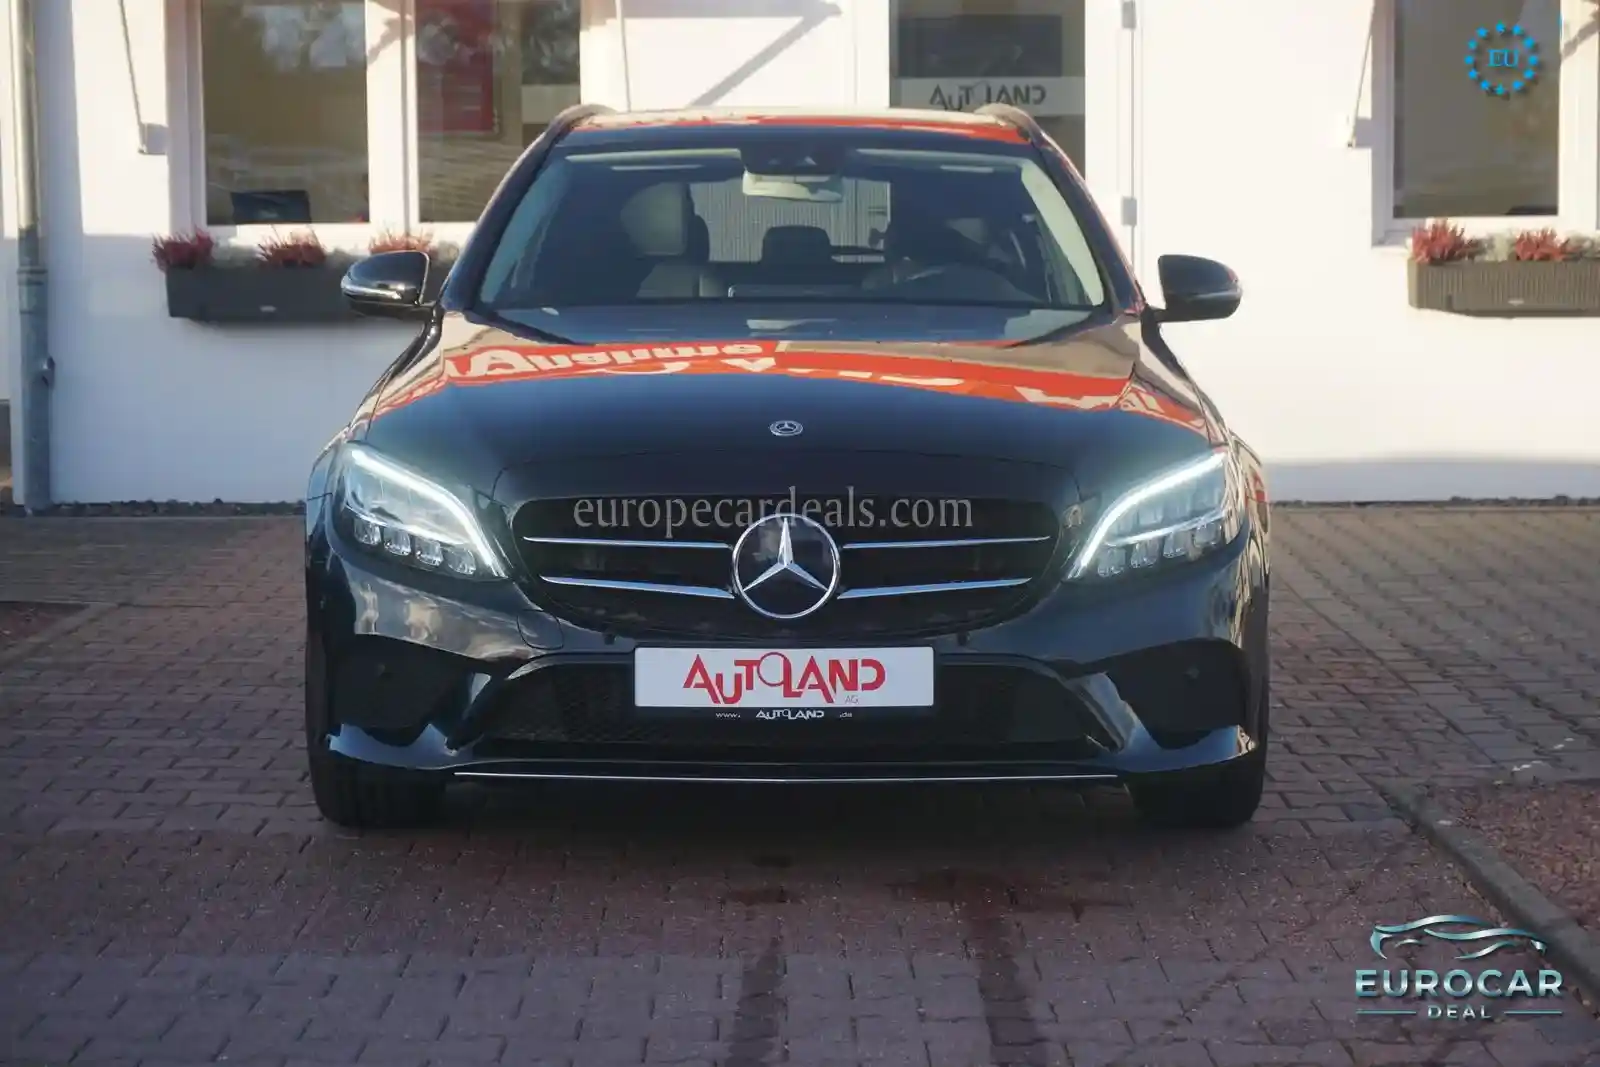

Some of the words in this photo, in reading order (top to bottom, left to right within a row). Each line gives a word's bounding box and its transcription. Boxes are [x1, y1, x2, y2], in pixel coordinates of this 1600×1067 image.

[683, 651, 886, 705] AUTOLAND
[715, 711, 741, 719] www.
[755, 708, 825, 720] AUTOLAND
